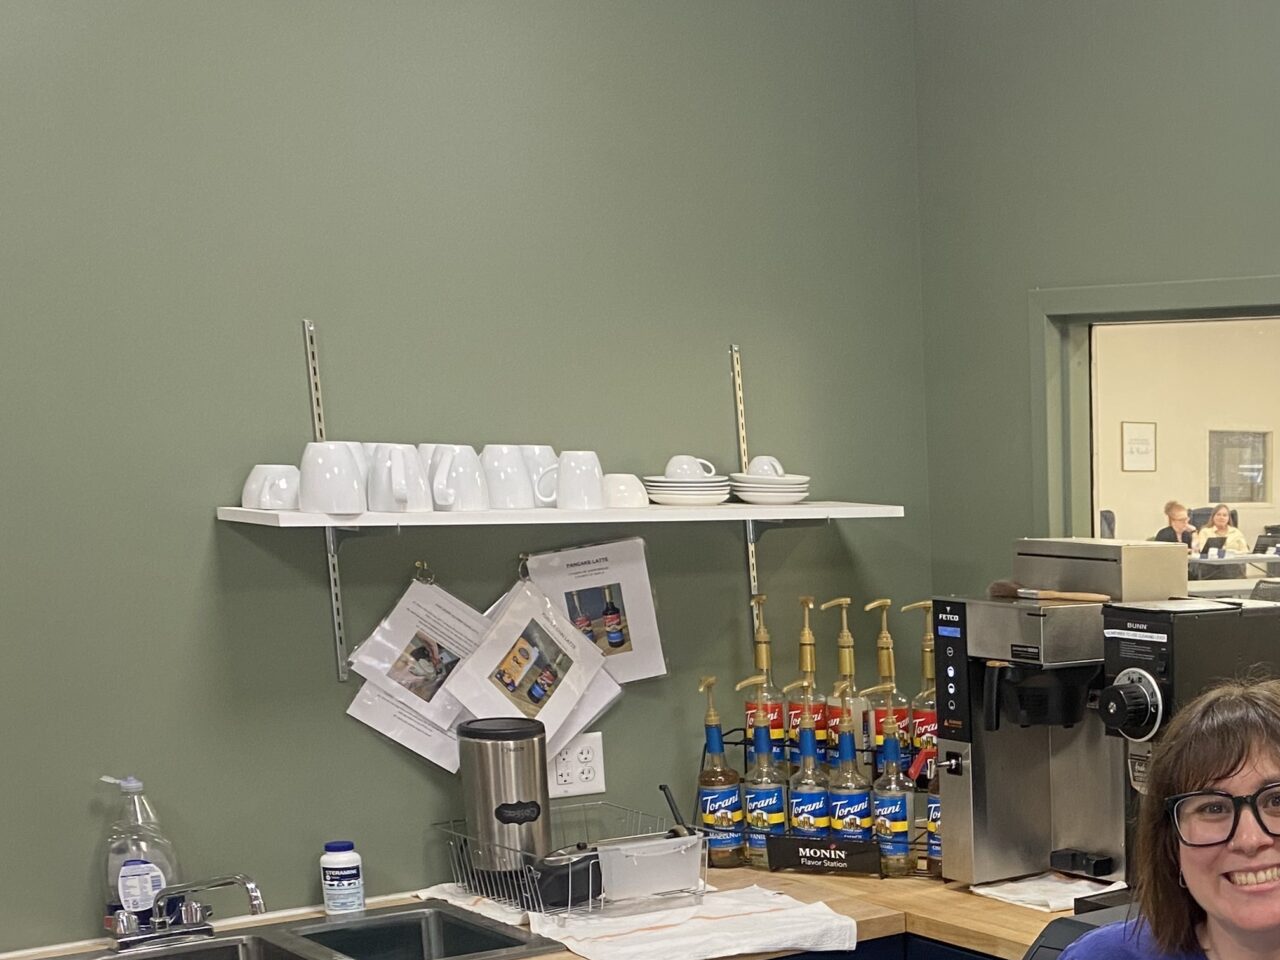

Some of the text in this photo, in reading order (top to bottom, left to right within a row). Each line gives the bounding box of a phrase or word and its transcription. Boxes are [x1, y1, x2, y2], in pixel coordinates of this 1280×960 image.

[592, 557, 608, 565] LATTE
[745, 708, 779, 729] Toni
[703, 790, 739, 815] Torani
[745, 793, 778, 813] Torani
[791, 797, 824, 817] Torani
[832, 797, 869, 820] Torani
[799, 847, 846, 859] MONIN
[801, 858, 848, 868] Flavor Station
